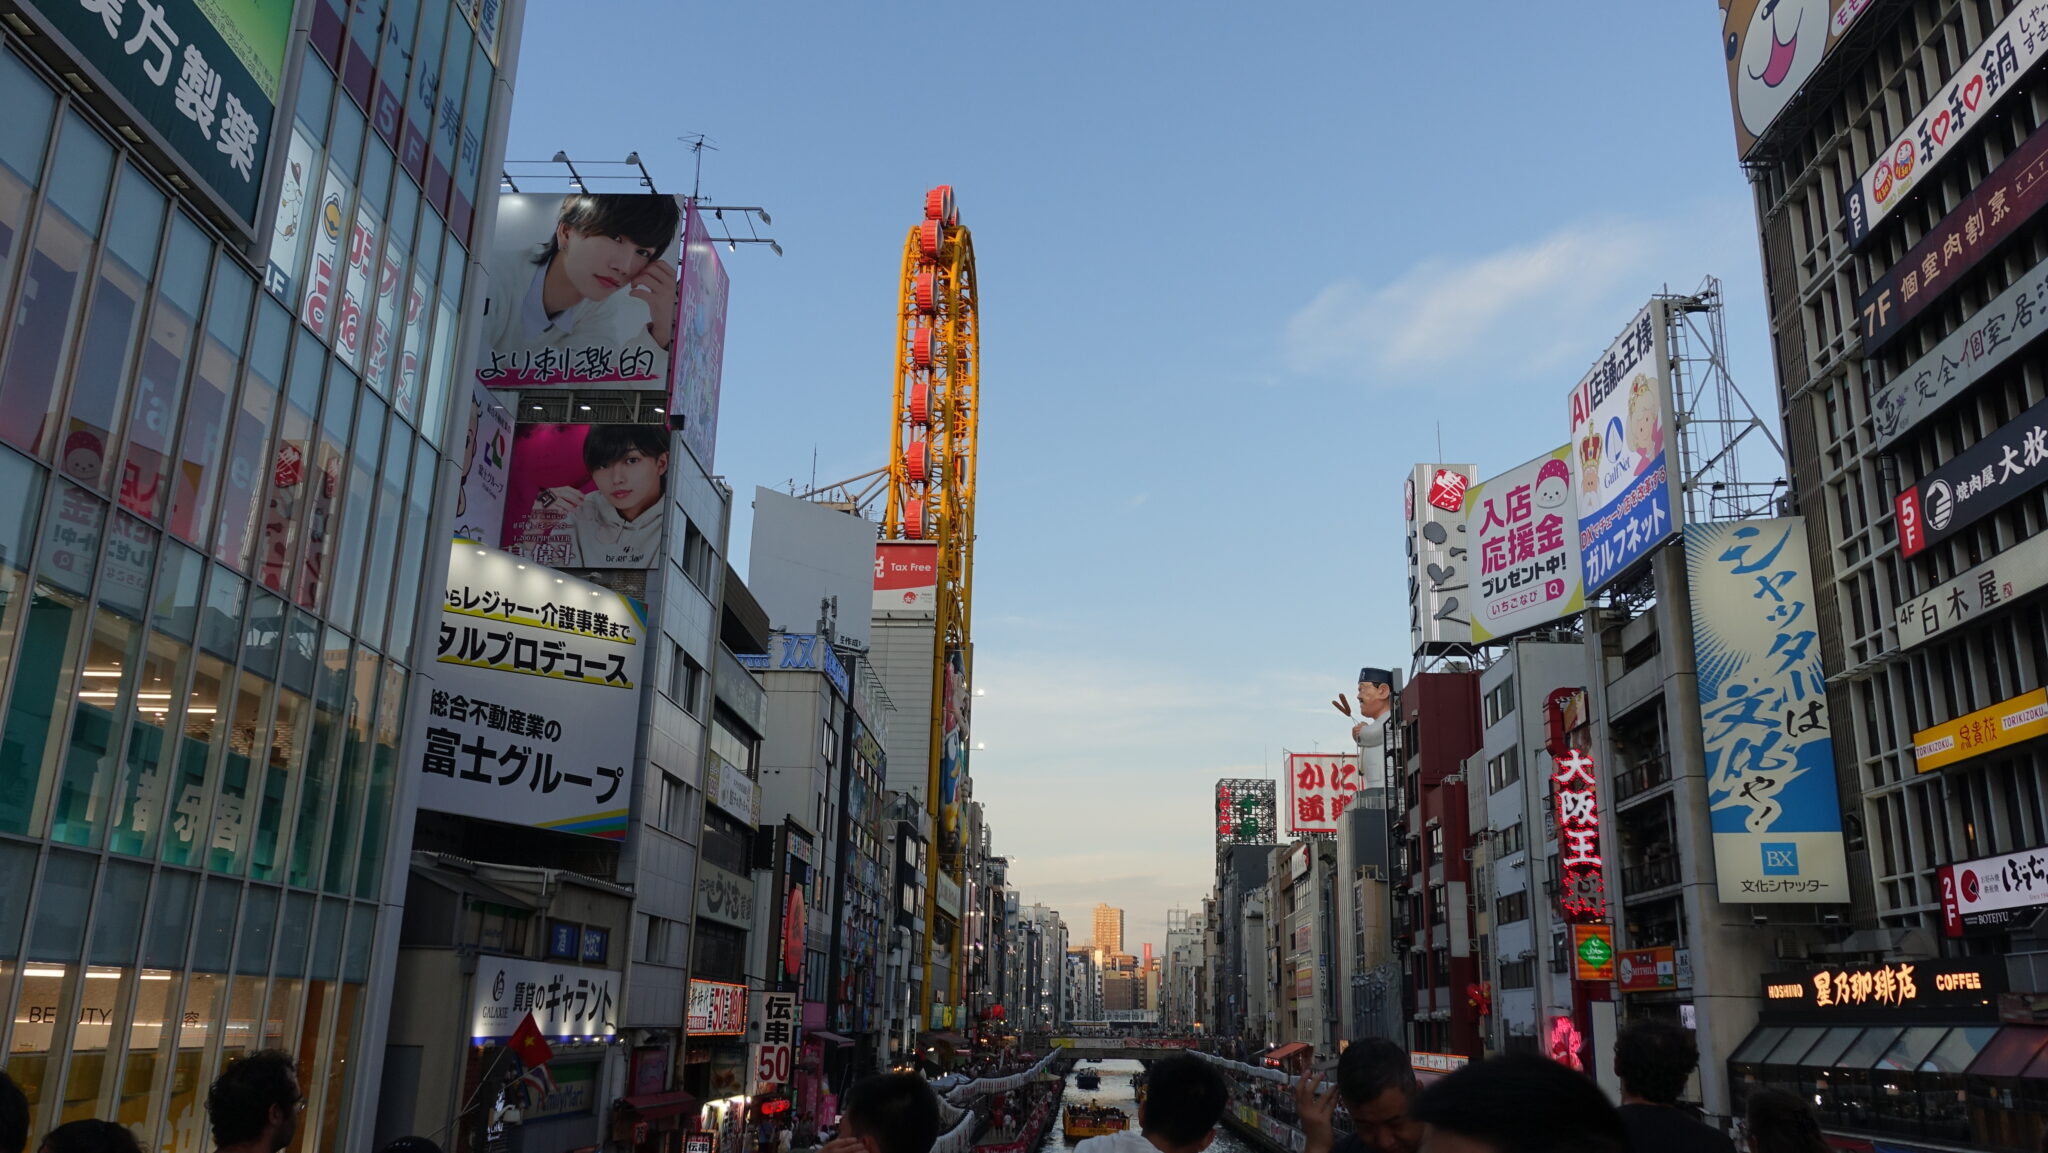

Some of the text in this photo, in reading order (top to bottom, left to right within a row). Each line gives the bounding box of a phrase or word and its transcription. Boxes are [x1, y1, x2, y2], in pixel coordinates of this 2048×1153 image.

[1864, 288, 1891, 338] 7F
[478, 344, 656, 380] より刺激的
[1571, 312, 1654, 433] AI店舗の王様
[1480, 482, 1531, 537] 入店
[1902, 496, 1915, 549] 5F
[891, 563, 931, 571] Tax Free
[1481, 513, 1565, 576] 応援金
[1586, 503, 1666, 587] ガルフネット
[1481, 552, 1567, 598] プレゼント中!
[1921, 570, 2001, 636] 白木屋
[429, 688, 562, 743] 総合不動産業の
[2003, 706, 2044, 728] TORIKIZOKU
[422, 726, 624, 804] 富士グループ
[1915, 739, 1949, 757] TORIKIZOKU
[1297, 762, 1357, 791] かに
[1767, 850, 1795, 867] BX
[2002, 854, 2048, 893] ぼてぢ
[1943, 877, 1956, 927] 2F
[1768, 963, 1981, 1007] HOSHINO 星乃珈琲店 COFFEE
[765, 996, 791, 1044] 伝串
[759, 1045, 789, 1081] 50
